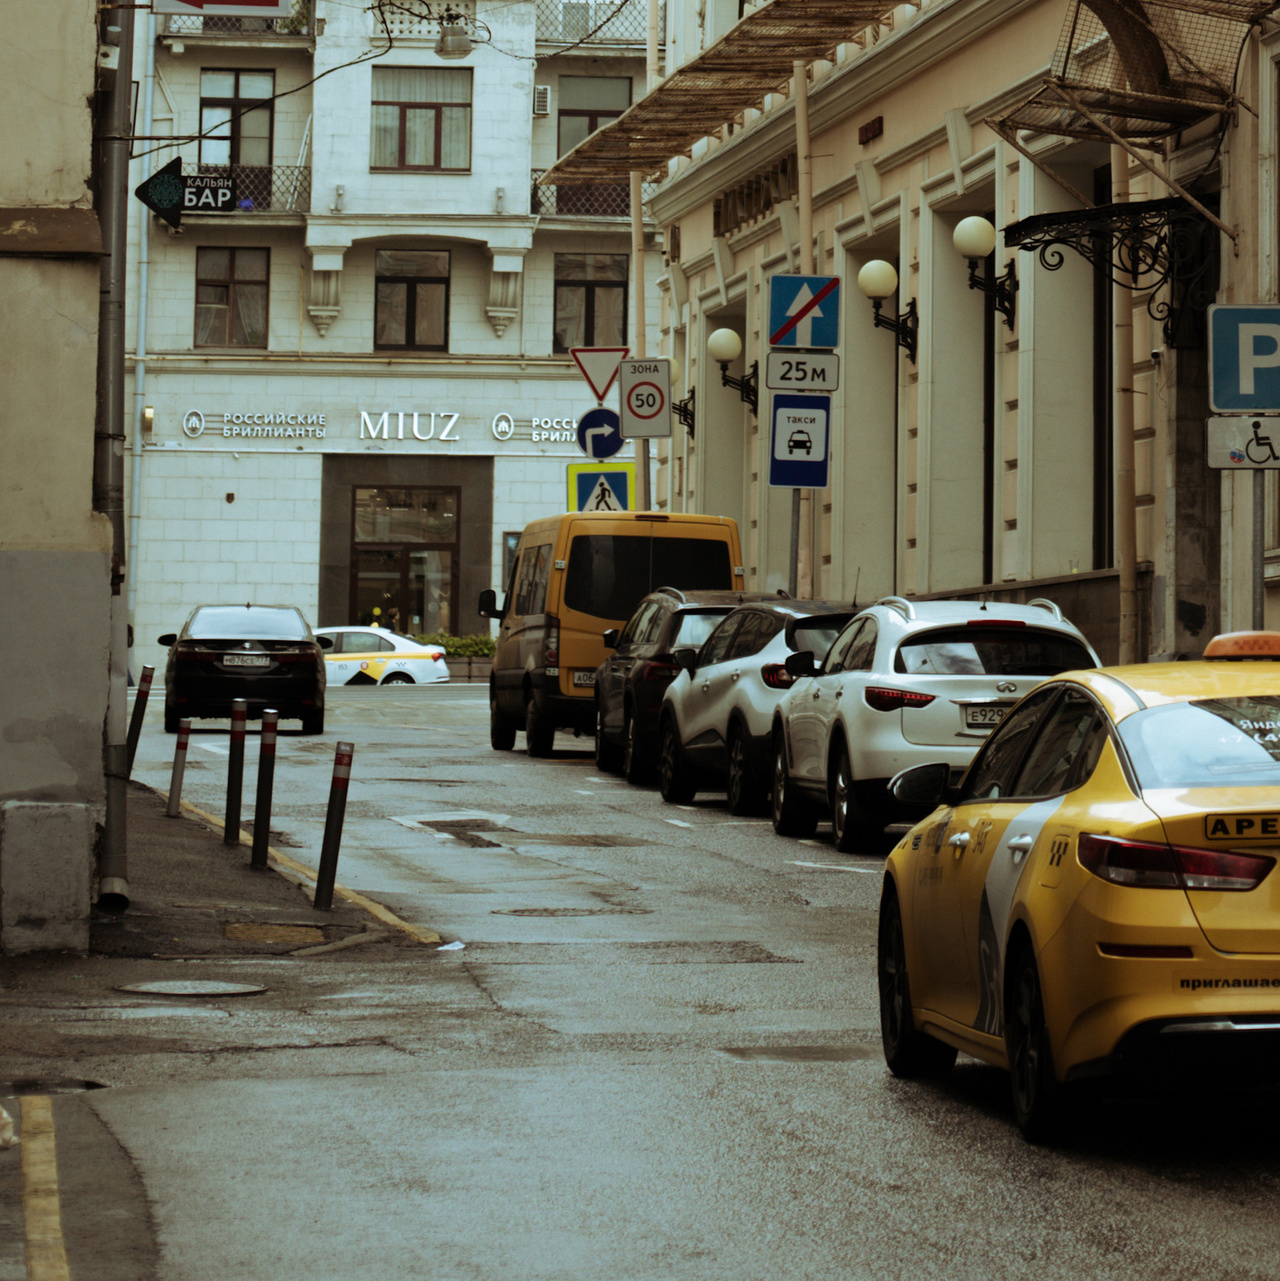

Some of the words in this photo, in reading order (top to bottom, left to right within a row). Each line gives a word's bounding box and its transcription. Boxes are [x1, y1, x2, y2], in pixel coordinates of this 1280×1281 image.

[187, 177, 232, 188] КАЛЬЯН
[184, 187, 231, 207] БАР
[630, 365, 659, 375] ЗОНА
[635, 393, 656, 408] 50
[223, 412, 326, 425] РОССИЙСКИЕ
[223, 426, 326, 438] БРИЛЛИАНТЫ
[360, 411, 460, 441] MIUZ
